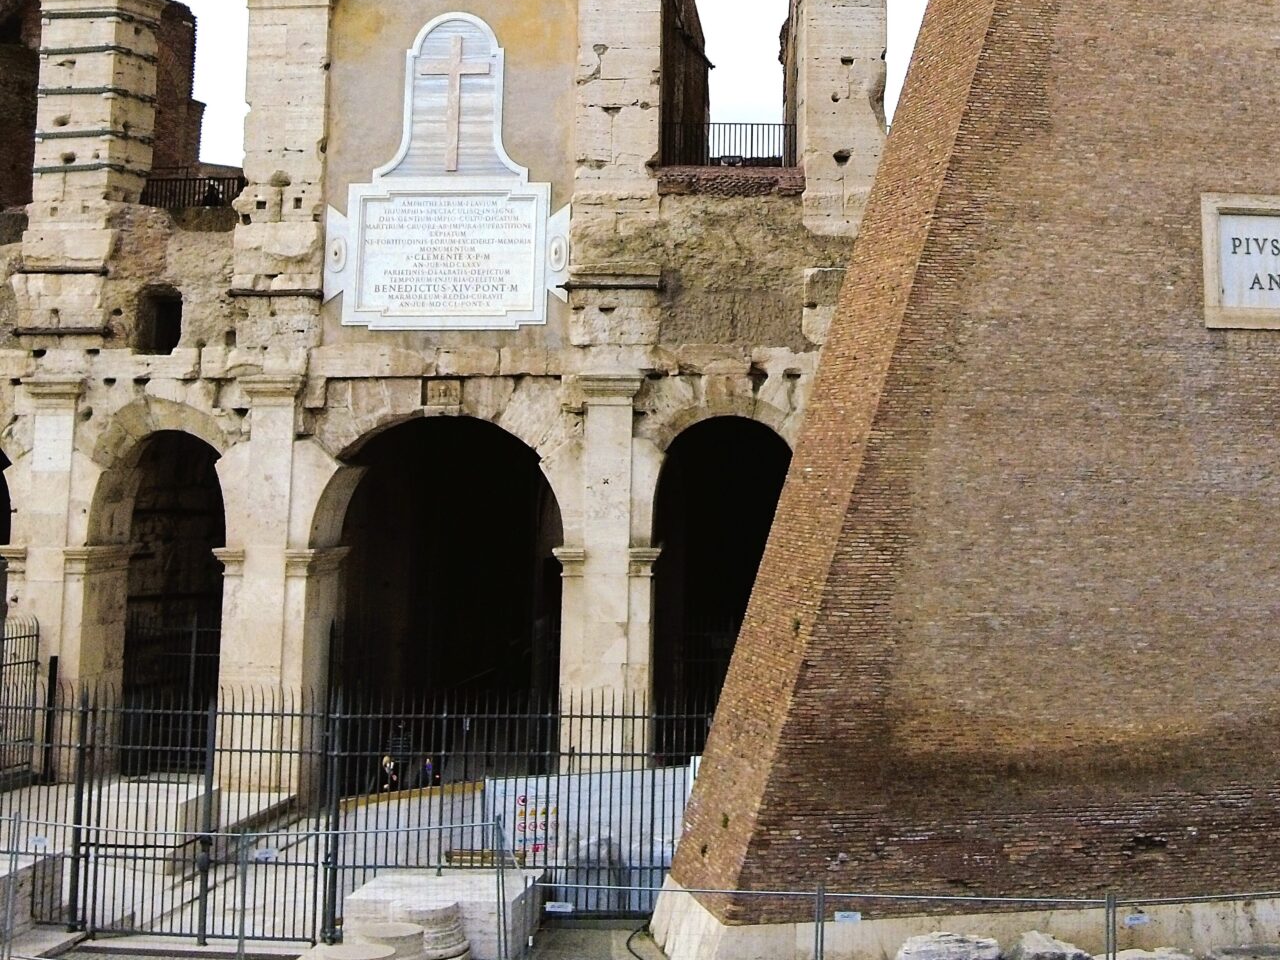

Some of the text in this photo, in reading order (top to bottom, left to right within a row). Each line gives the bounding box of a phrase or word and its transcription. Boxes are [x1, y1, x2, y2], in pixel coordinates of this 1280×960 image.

[1231, 237, 1280, 256] PIVS
[374, 284, 446, 292] BENEDICTUS
[452, 284, 471, 292] XIV
[475, 284, 506, 292] PONT
